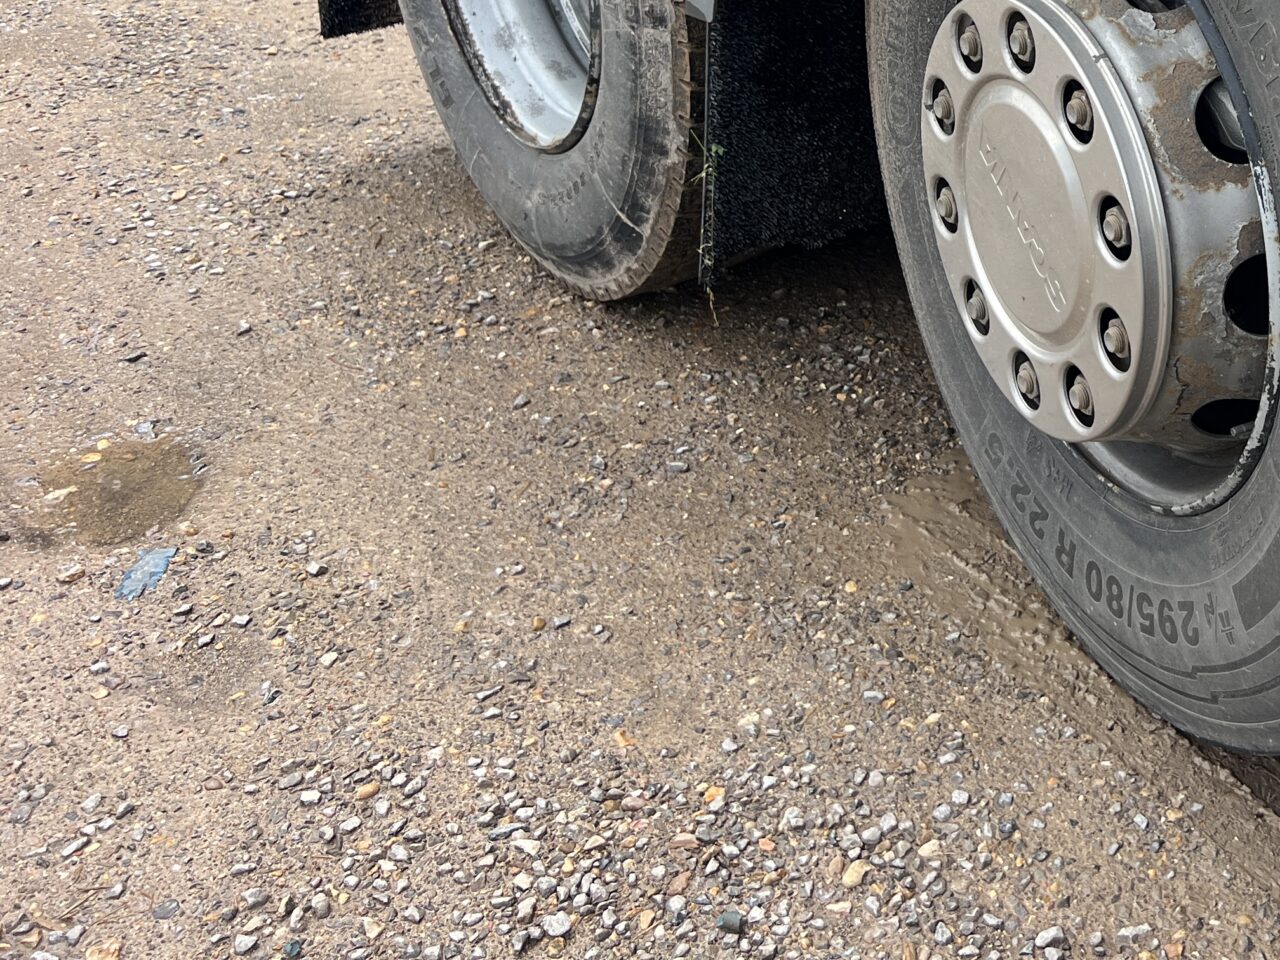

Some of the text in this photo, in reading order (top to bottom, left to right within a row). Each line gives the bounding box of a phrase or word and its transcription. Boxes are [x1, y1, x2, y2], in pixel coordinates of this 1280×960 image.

[977, 120, 1068, 314] SCANIA
[984, 431, 1200, 648] 295/80 R 22.5
